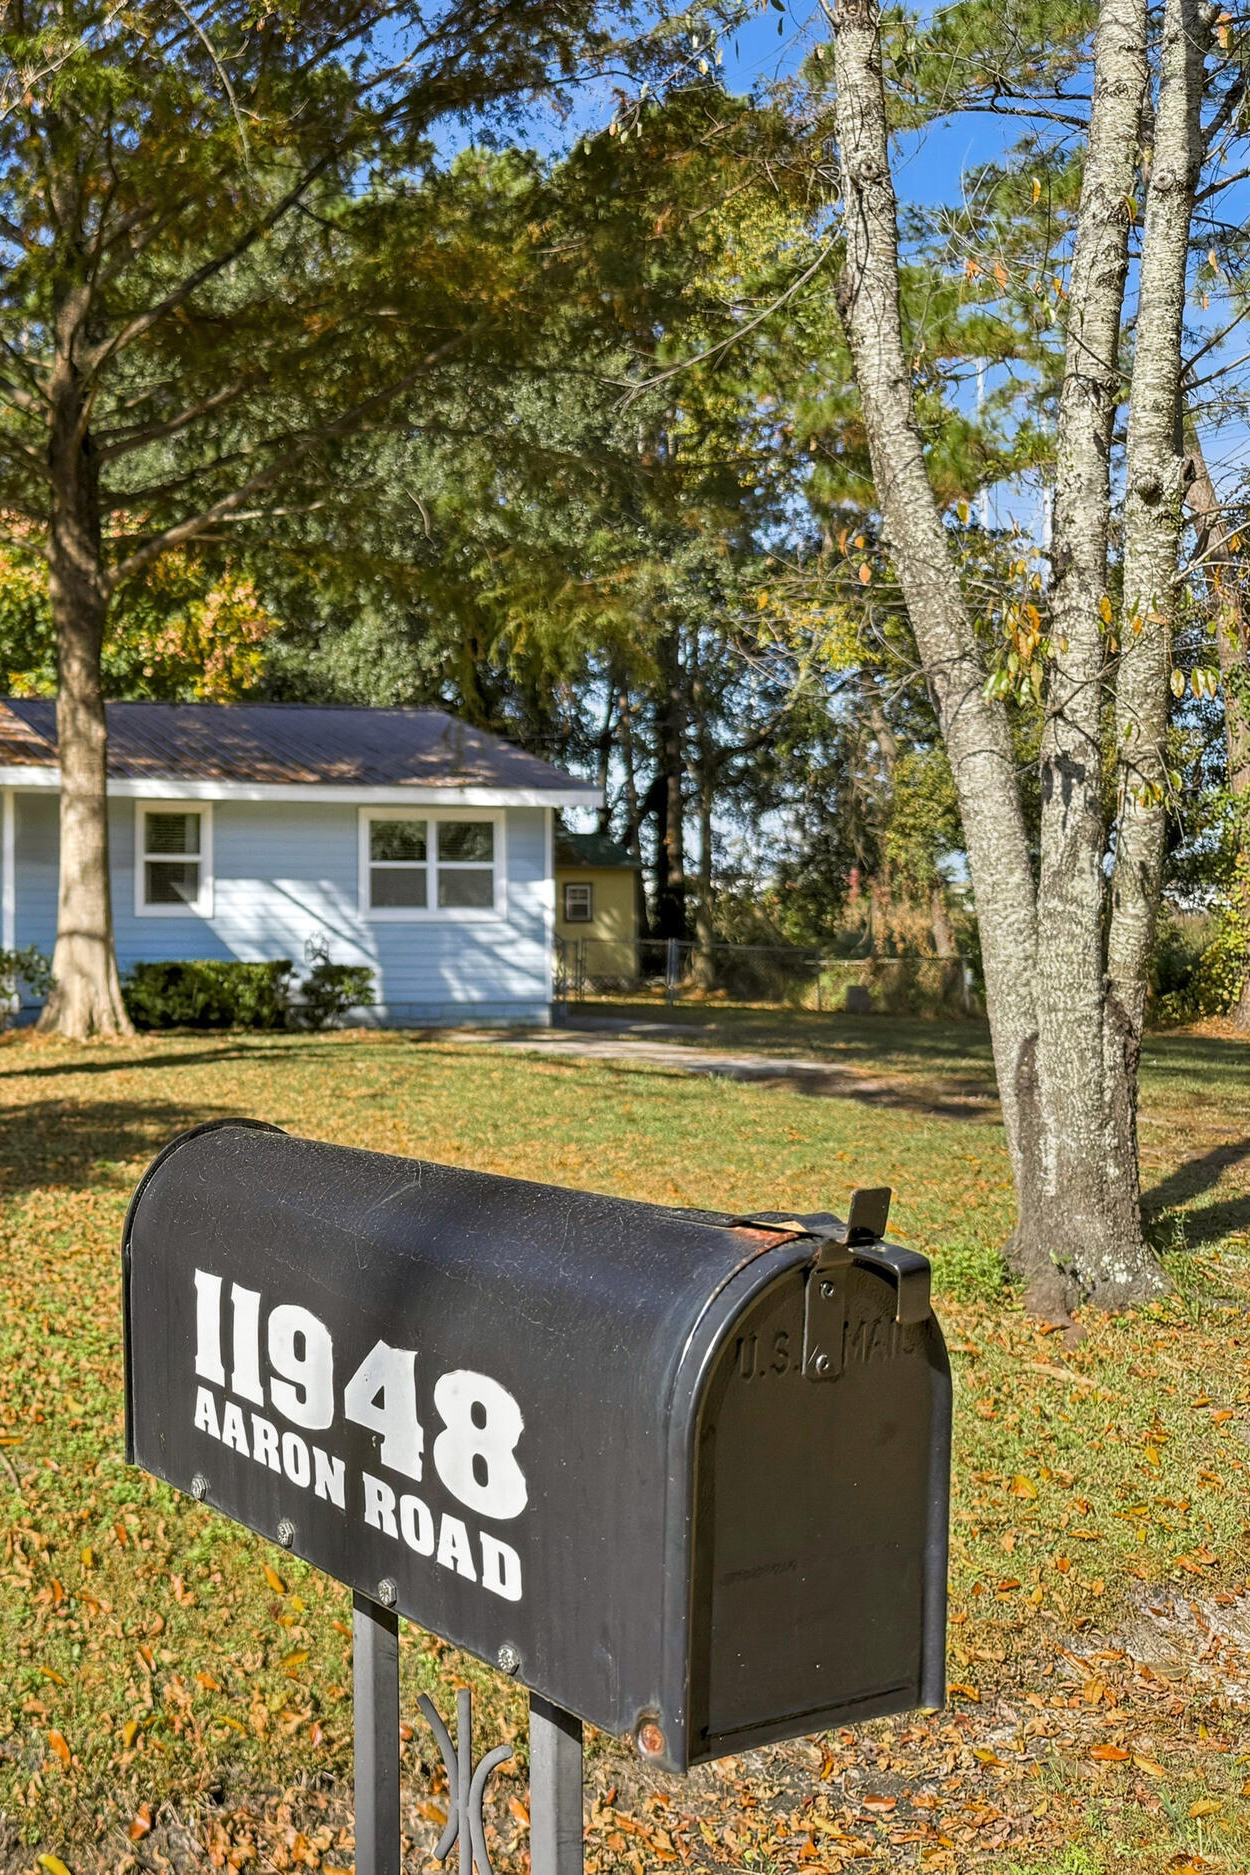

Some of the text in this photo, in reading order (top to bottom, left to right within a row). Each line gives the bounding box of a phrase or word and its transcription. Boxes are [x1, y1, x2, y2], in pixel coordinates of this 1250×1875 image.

[194, 1268, 528, 1520] 11948
[735, 1329, 800, 1384] U.S.
[194, 1386, 523, 1602] AARON ROAD
